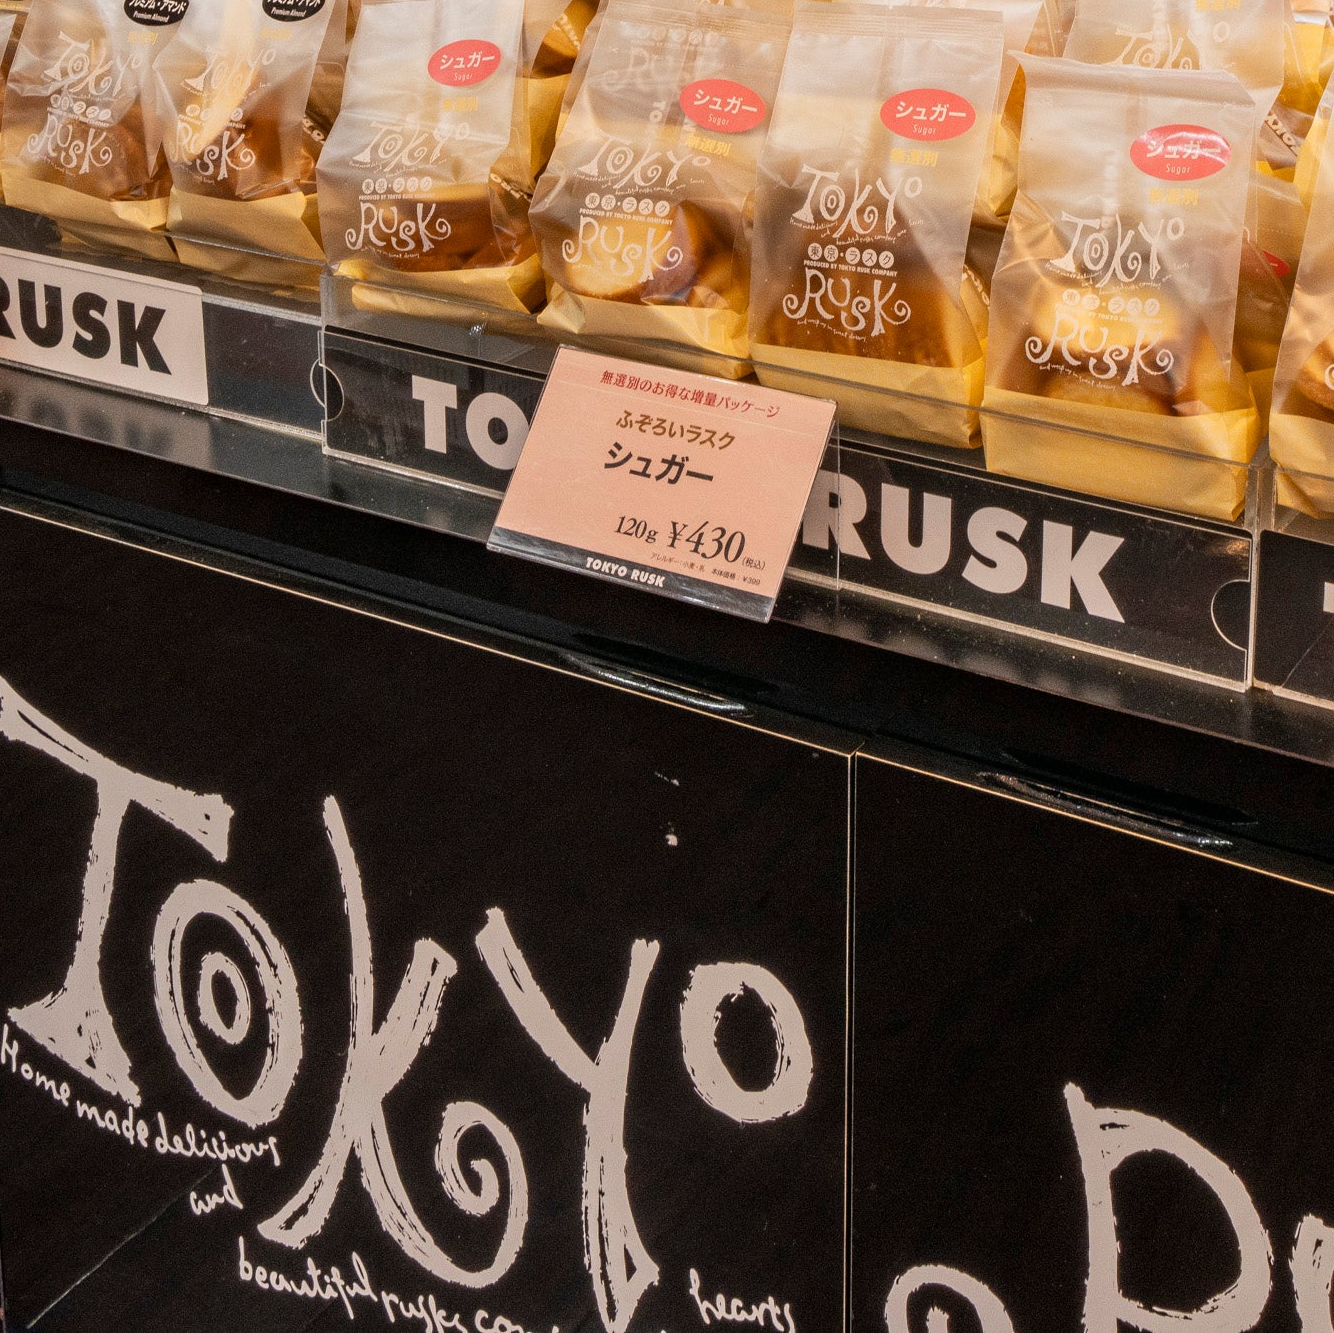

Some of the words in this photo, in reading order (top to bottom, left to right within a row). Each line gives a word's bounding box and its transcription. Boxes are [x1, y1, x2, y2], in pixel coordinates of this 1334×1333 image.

[439, 52, 496, 70] シュガー
[693, 88, 758, 114] シュガー
[895, 101, 967, 122] シュガー
[27, 117, 113, 175] RUSK
[1145, 138, 1221, 160] シュガー
[345, 202, 452, 252] RUSK
[562, 217, 684, 283] RUSK
[1050, 210, 1185, 288] TOKYO
[808, 242, 895, 269] 東京・ラスク
[783, 267, 912, 337] RUSK
[1025, 315, 1175, 387] RUSK
[600, 370, 780, 419] 無選別のお得な増量パッケージ
[616, 409, 736, 451] ふぞろいラスク
[603, 441, 714, 485] シュガー
[614, 514, 659, 545] 120g
[667, 519, 747, 565] ¥430
[801, 470, 1126, 624] RUSK
[584, 555, 627, 578] TOKYO
[631, 567, 666, 588] RUSK
[0, 1023, 71, 1107] Home
[76, 1100, 148, 1148] made
[189, 1163, 244, 1216] and
